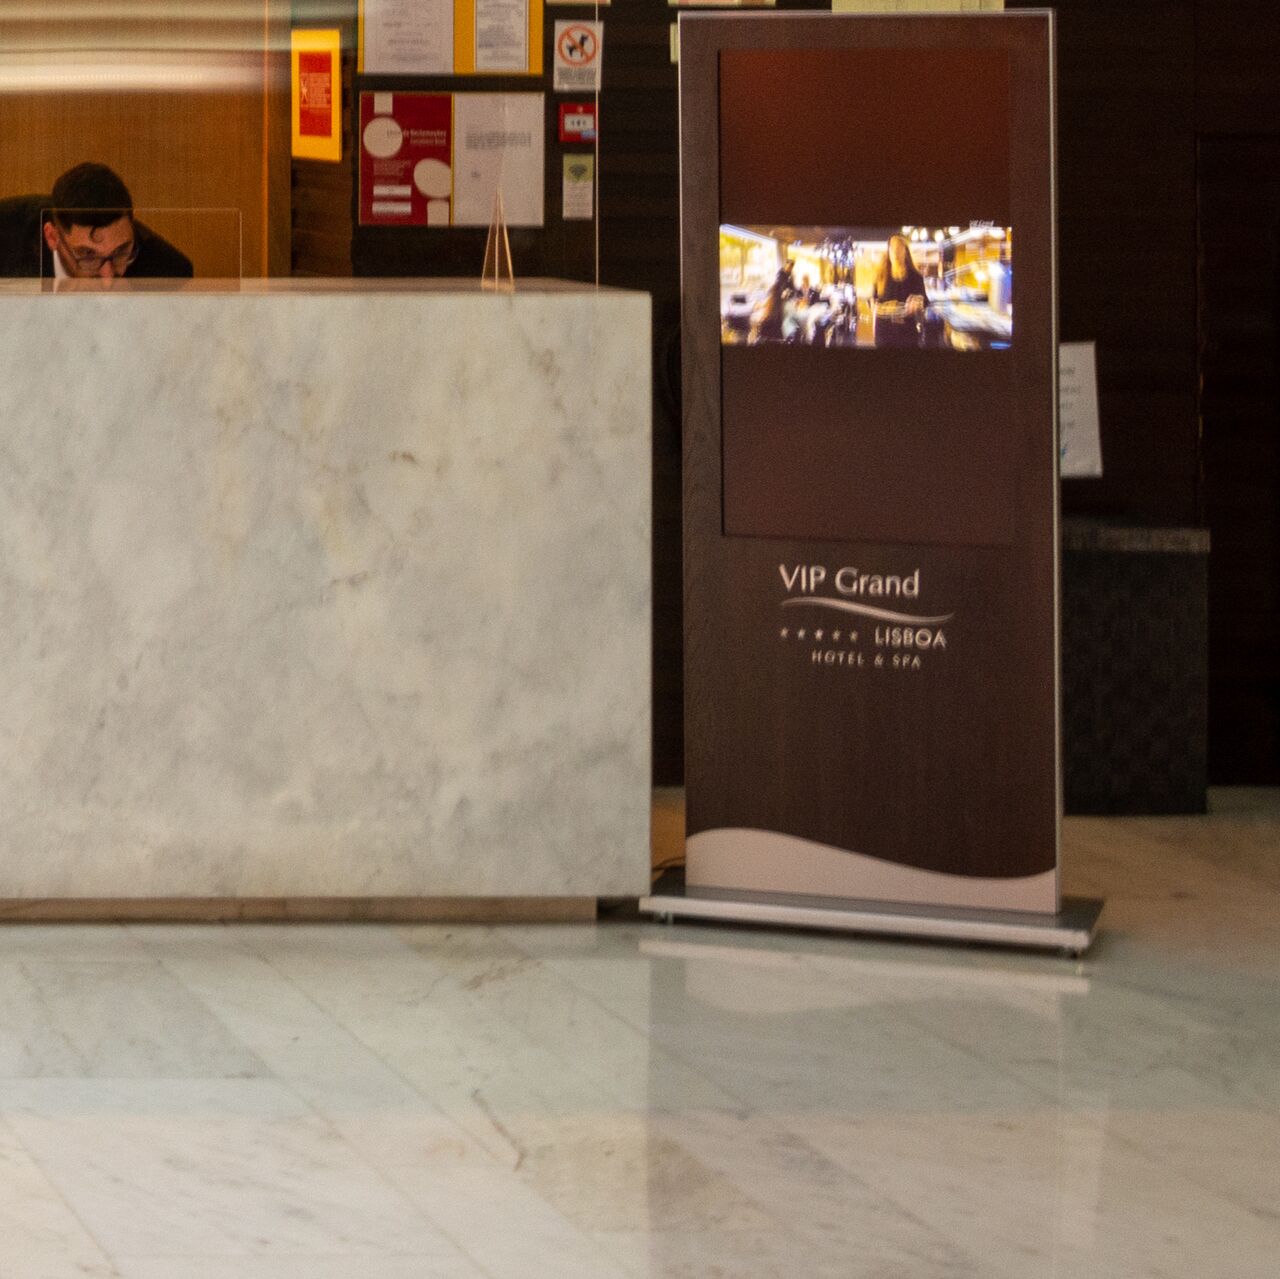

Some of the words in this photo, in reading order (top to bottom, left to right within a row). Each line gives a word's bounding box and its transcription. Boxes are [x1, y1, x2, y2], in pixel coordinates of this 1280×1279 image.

[778, 563, 827, 594] VIP
[834, 566, 920, 599] Grand
[874, 625, 948, 650] LISBOA
[811, 649, 865, 666] HOTEL
[874, 653, 884, 668] &
[892, 655, 922, 670] SPA
